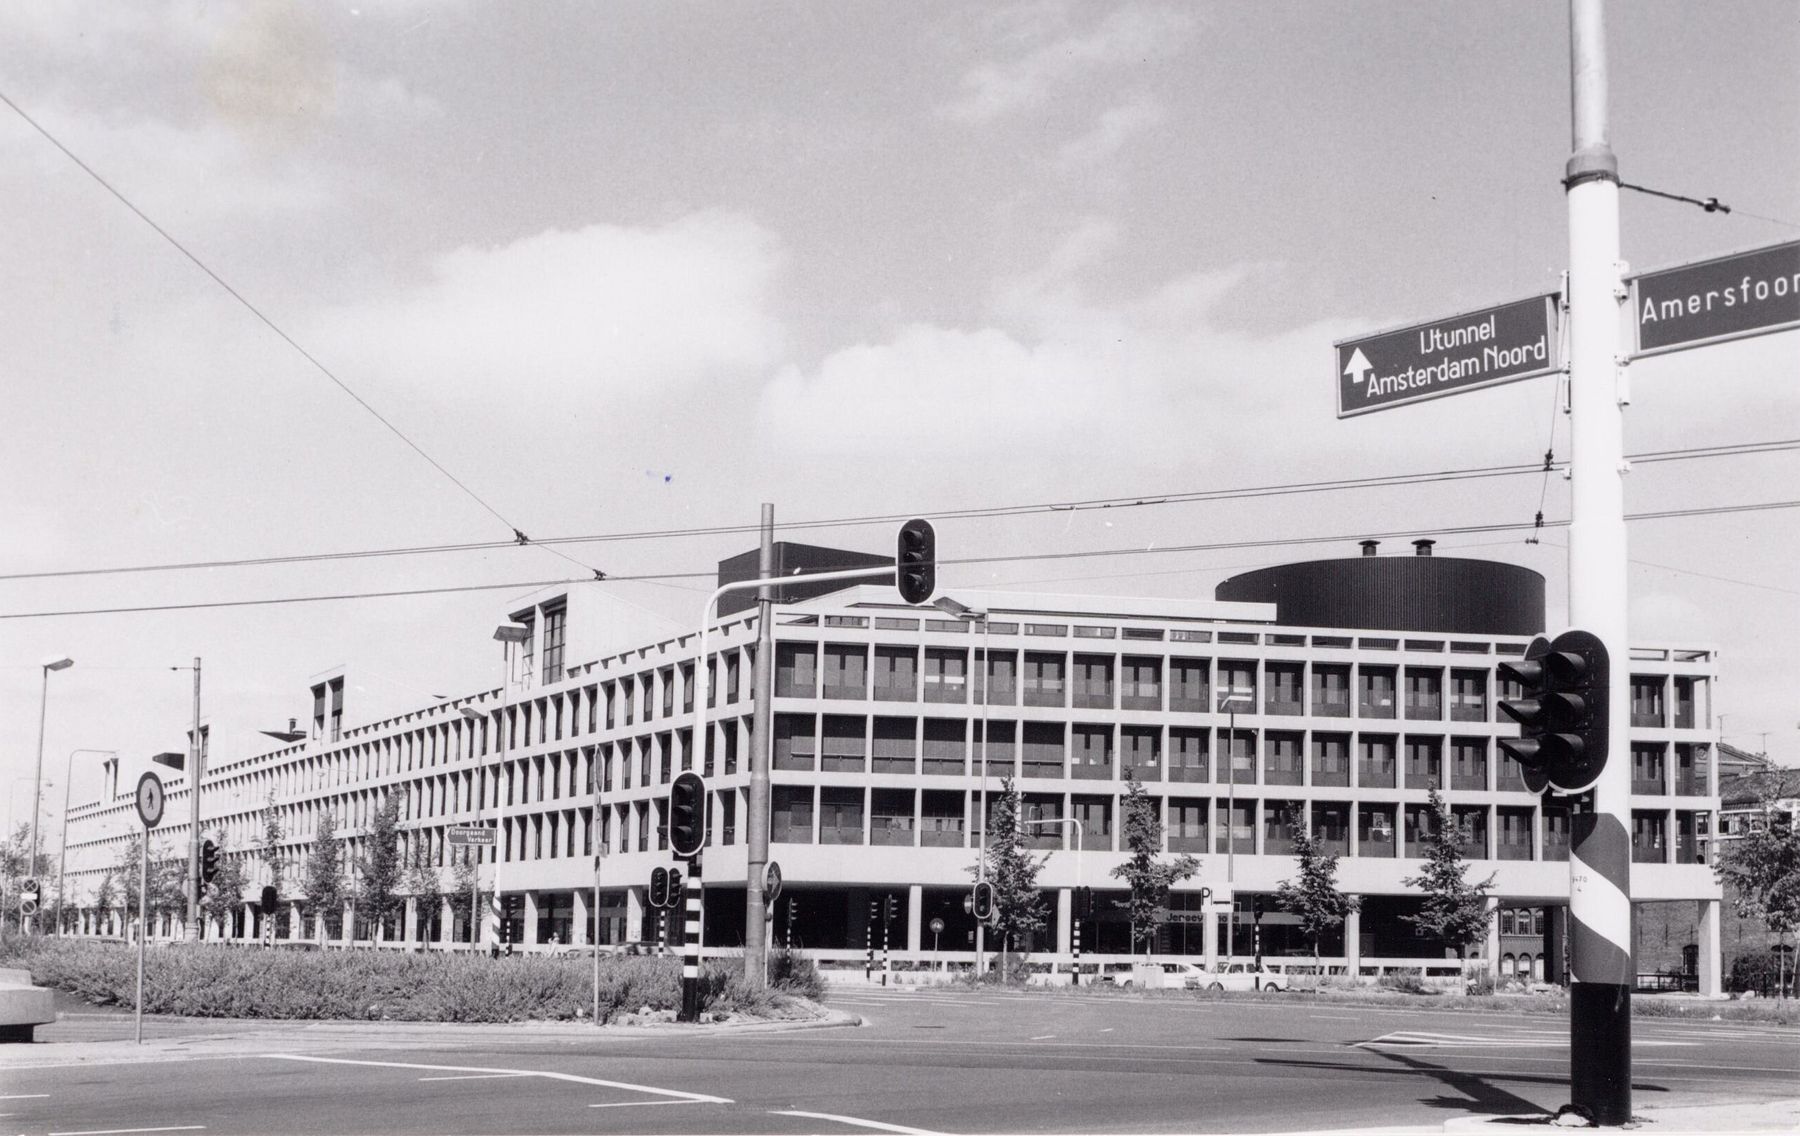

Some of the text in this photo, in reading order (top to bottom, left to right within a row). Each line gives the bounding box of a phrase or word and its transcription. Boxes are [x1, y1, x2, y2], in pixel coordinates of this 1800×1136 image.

[1420, 314, 1496, 355] IJtunnel
[1366, 335, 1546, 398] Amsterdam Noord
[1201, 887, 1211, 905] P
